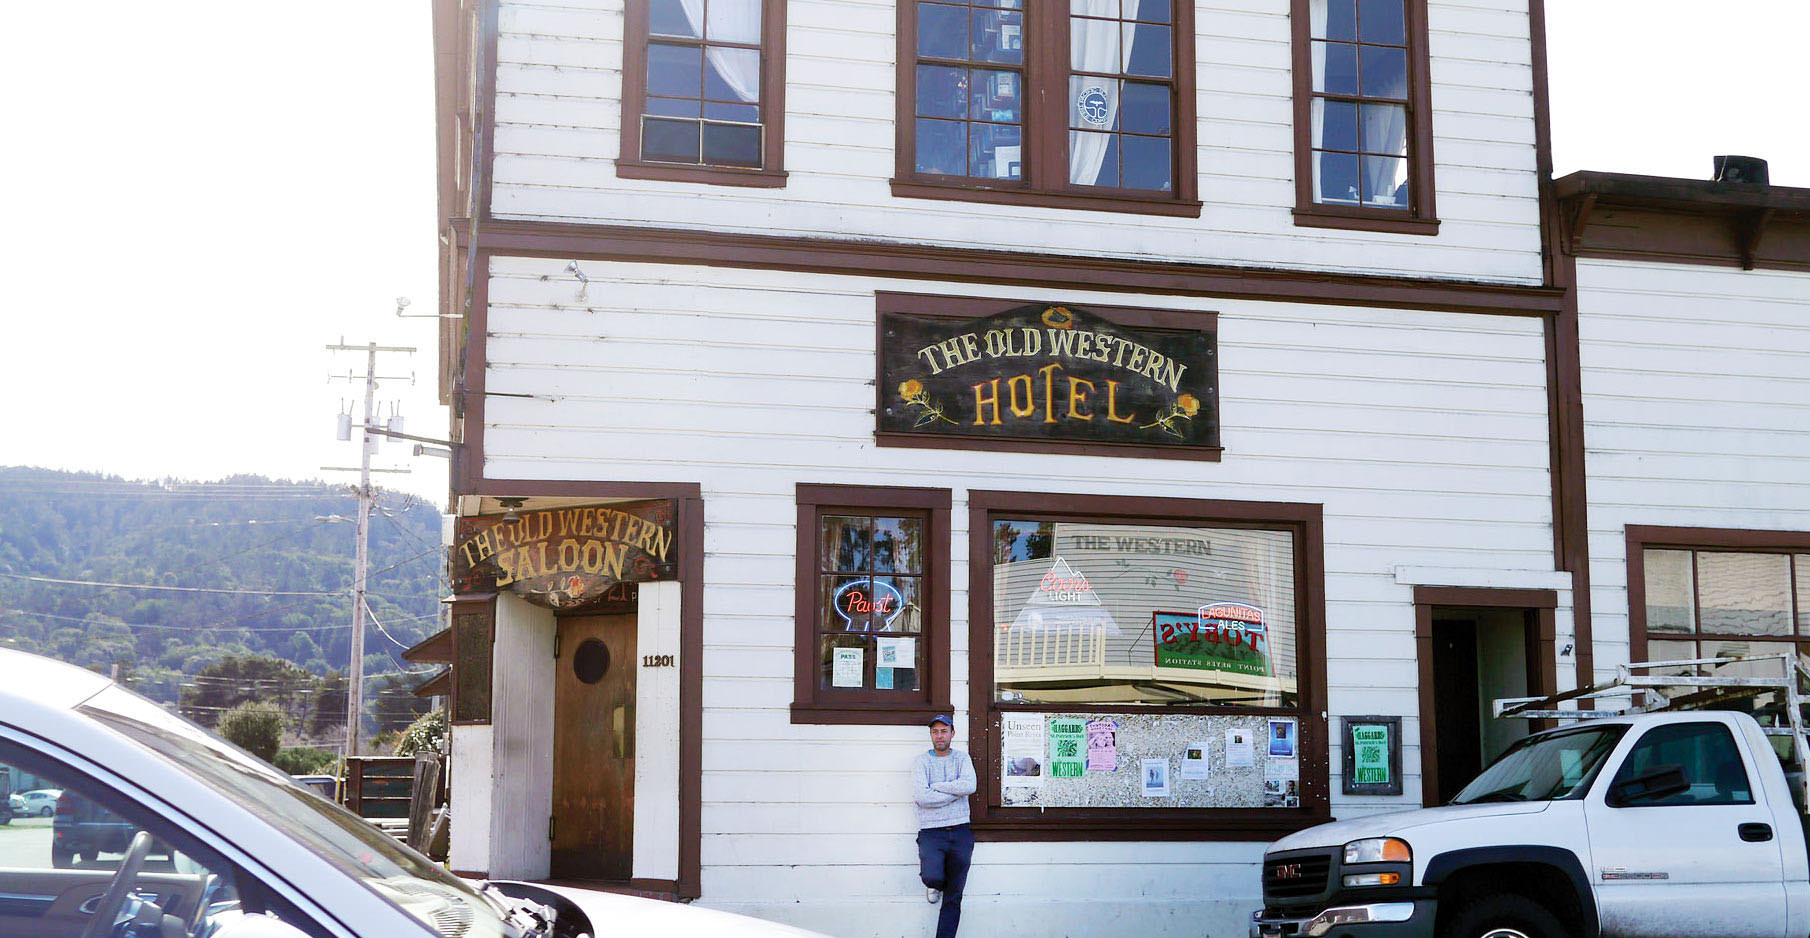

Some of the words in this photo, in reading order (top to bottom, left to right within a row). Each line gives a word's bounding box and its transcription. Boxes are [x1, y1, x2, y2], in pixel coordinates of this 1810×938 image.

[917, 332, 982, 375] THE
[984, 328, 1042, 358] OLD
[1049, 329, 1188, 393] WESTERN
[971, 362, 1135, 426] HOTEL
[458, 523, 507, 569] THE
[508, 511, 553, 545] OLD
[558, 507, 672, 563] WESTERN
[1072, 535, 1111, 551] THE
[1114, 536, 1212, 556] WESTERN
[496, 538, 629, 587] SALOON
[1040, 571, 1093, 592] Coors
[1049, 591, 1083, 601] LIGHT
[1201, 605, 1262, 622] LAGUNITAS
[1217, 619, 1246, 632] ALES
[642, 654, 675, 668] 11201
[1007, 720, 1042, 731] Unseen
[1052, 761, 1083, 777] WESTERN
[1357, 768, 1386, 781] WESTERN
